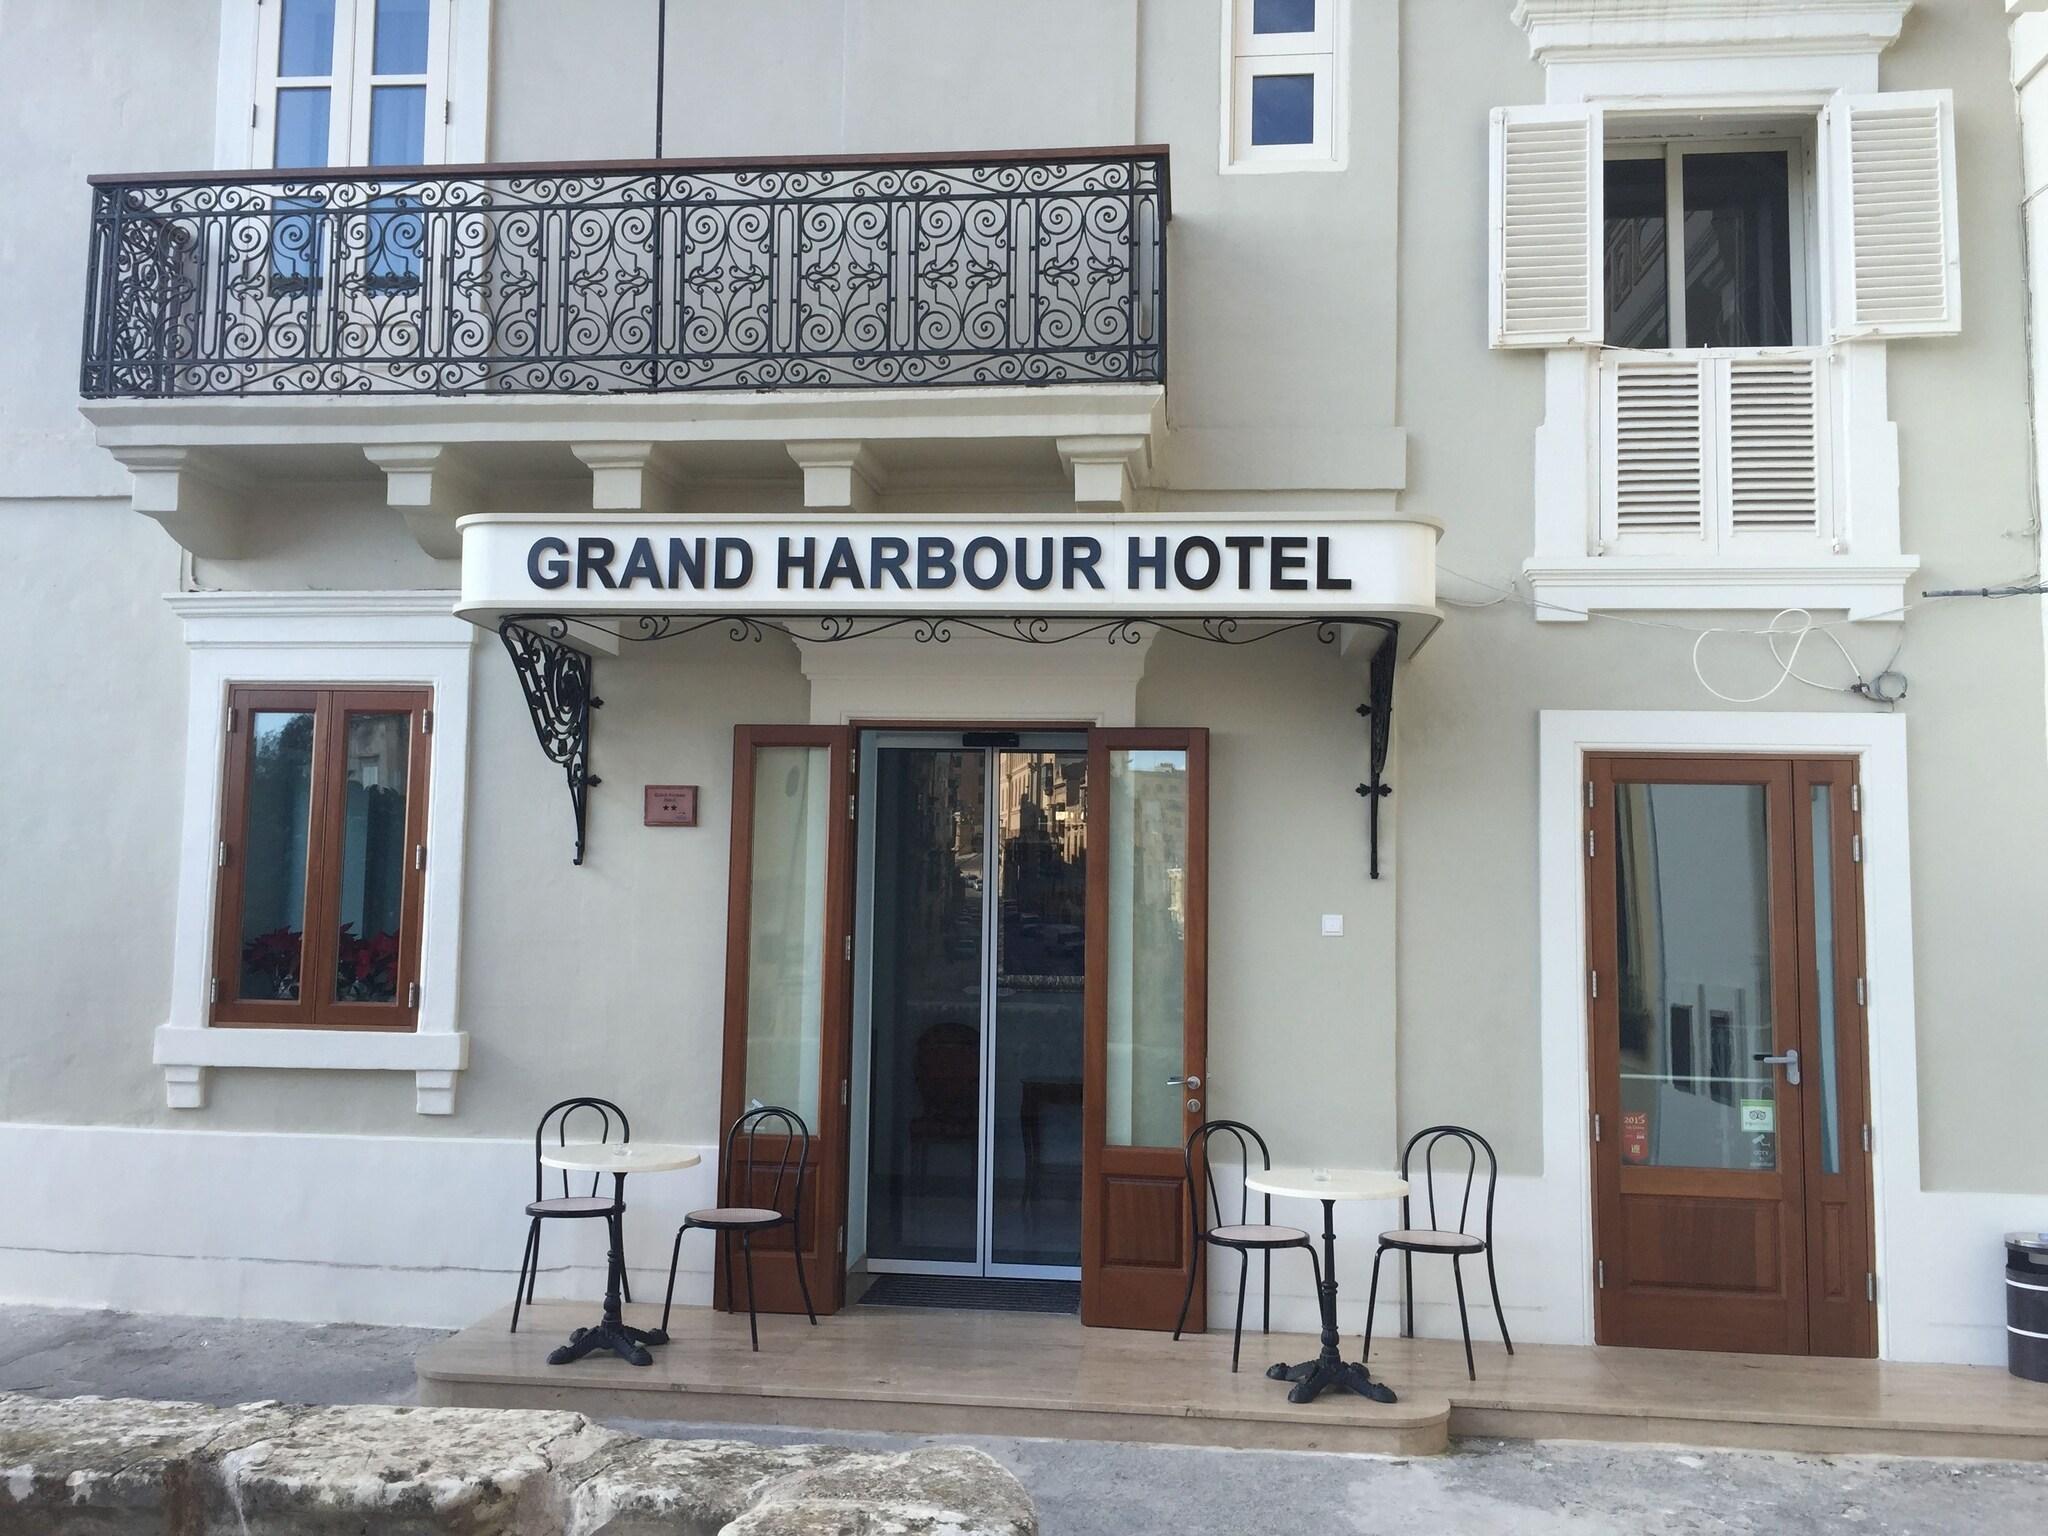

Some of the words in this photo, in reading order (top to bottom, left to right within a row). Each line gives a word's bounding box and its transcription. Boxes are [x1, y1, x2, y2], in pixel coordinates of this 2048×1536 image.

[528, 536, 754, 590] GRAND
[777, 536, 1106, 590] HARBOUR
[1127, 536, 1352, 590] HOTEL
[1624, 1115, 1646, 1125] 2015
